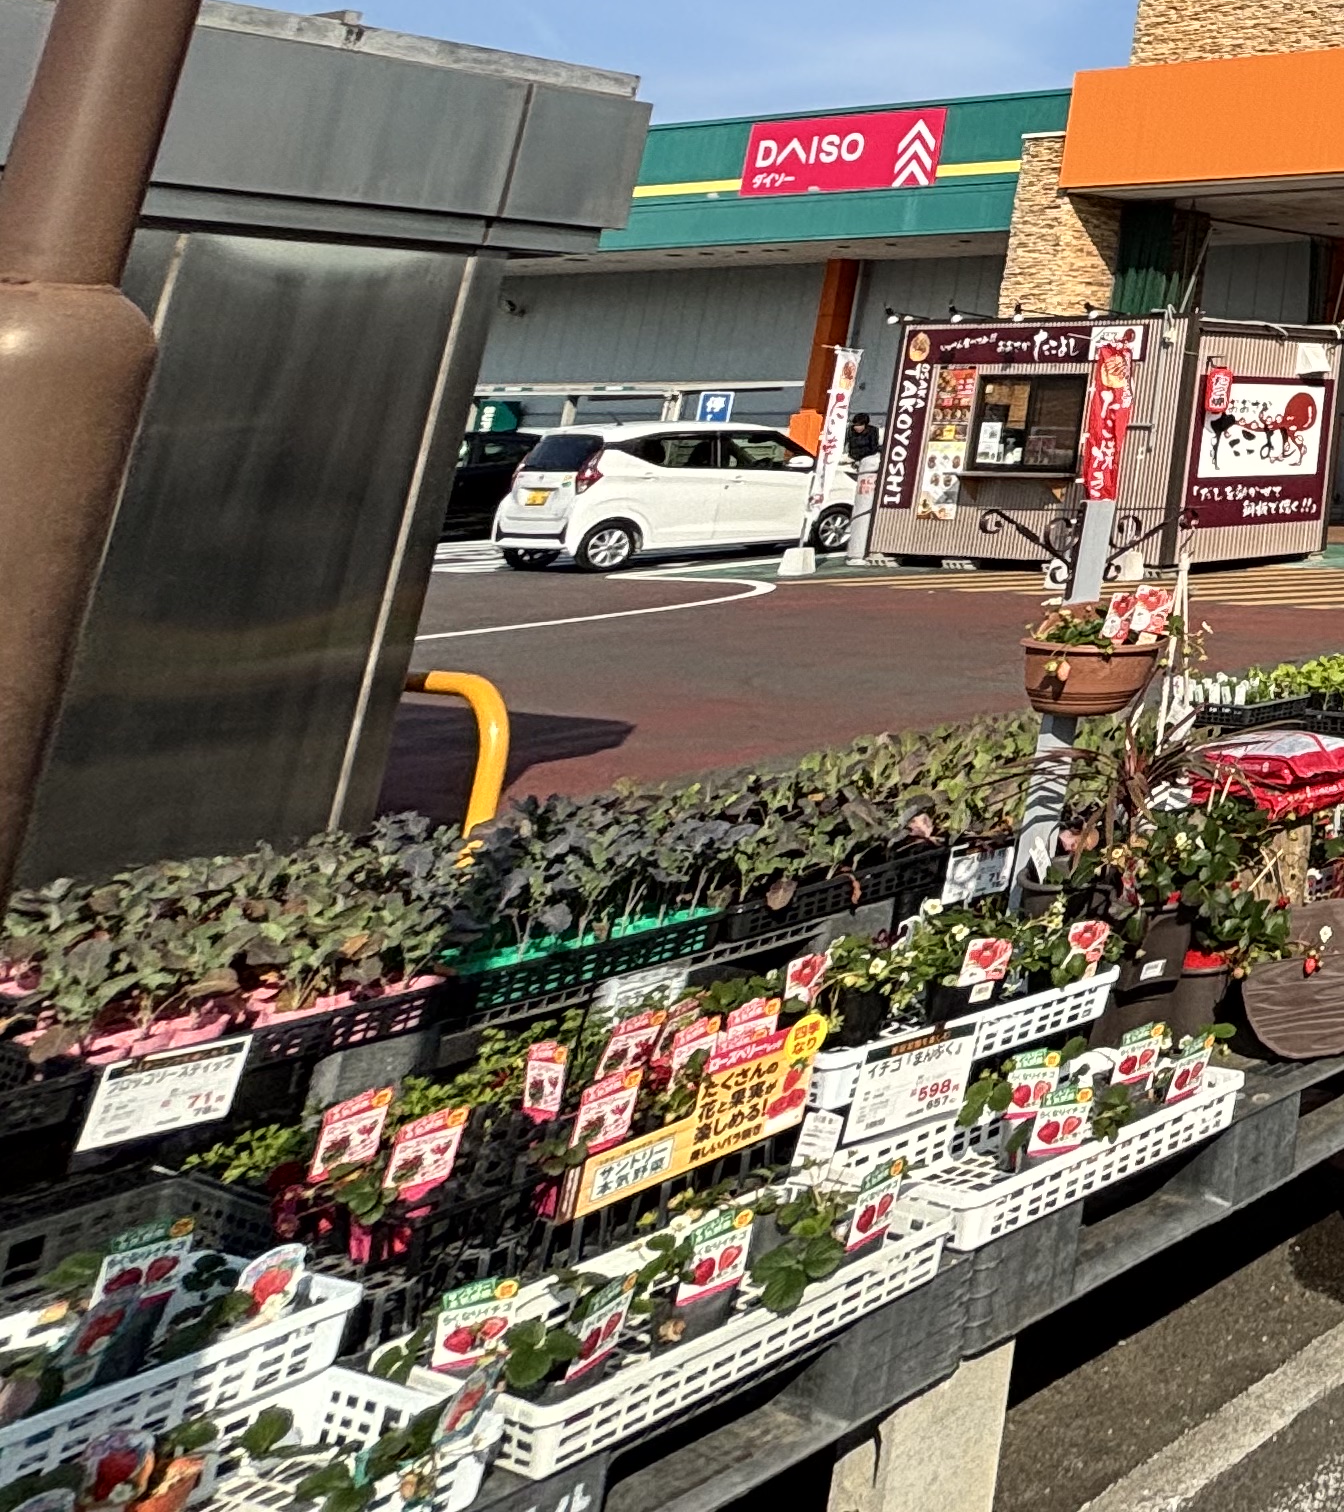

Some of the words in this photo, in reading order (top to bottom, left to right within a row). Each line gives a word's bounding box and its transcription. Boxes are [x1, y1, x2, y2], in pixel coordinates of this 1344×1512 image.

[755, 132, 865, 168] DAISO
[752, 172, 796, 188] ダイソー
[1034, 329, 1079, 361] たこよし
[915, 363, 931, 409] OSAKA
[883, 368, 923, 506] TAKOYOSHI
[792, 1036, 818, 1055] なり
[794, 1020, 821, 1041] 四季
[702, 1061, 779, 1101] たくさんの
[697, 1079, 780, 1122] 花と果実が
[693, 1098, 769, 1146] 楽しめる!
[600, 1145, 669, 1177] サントリー
